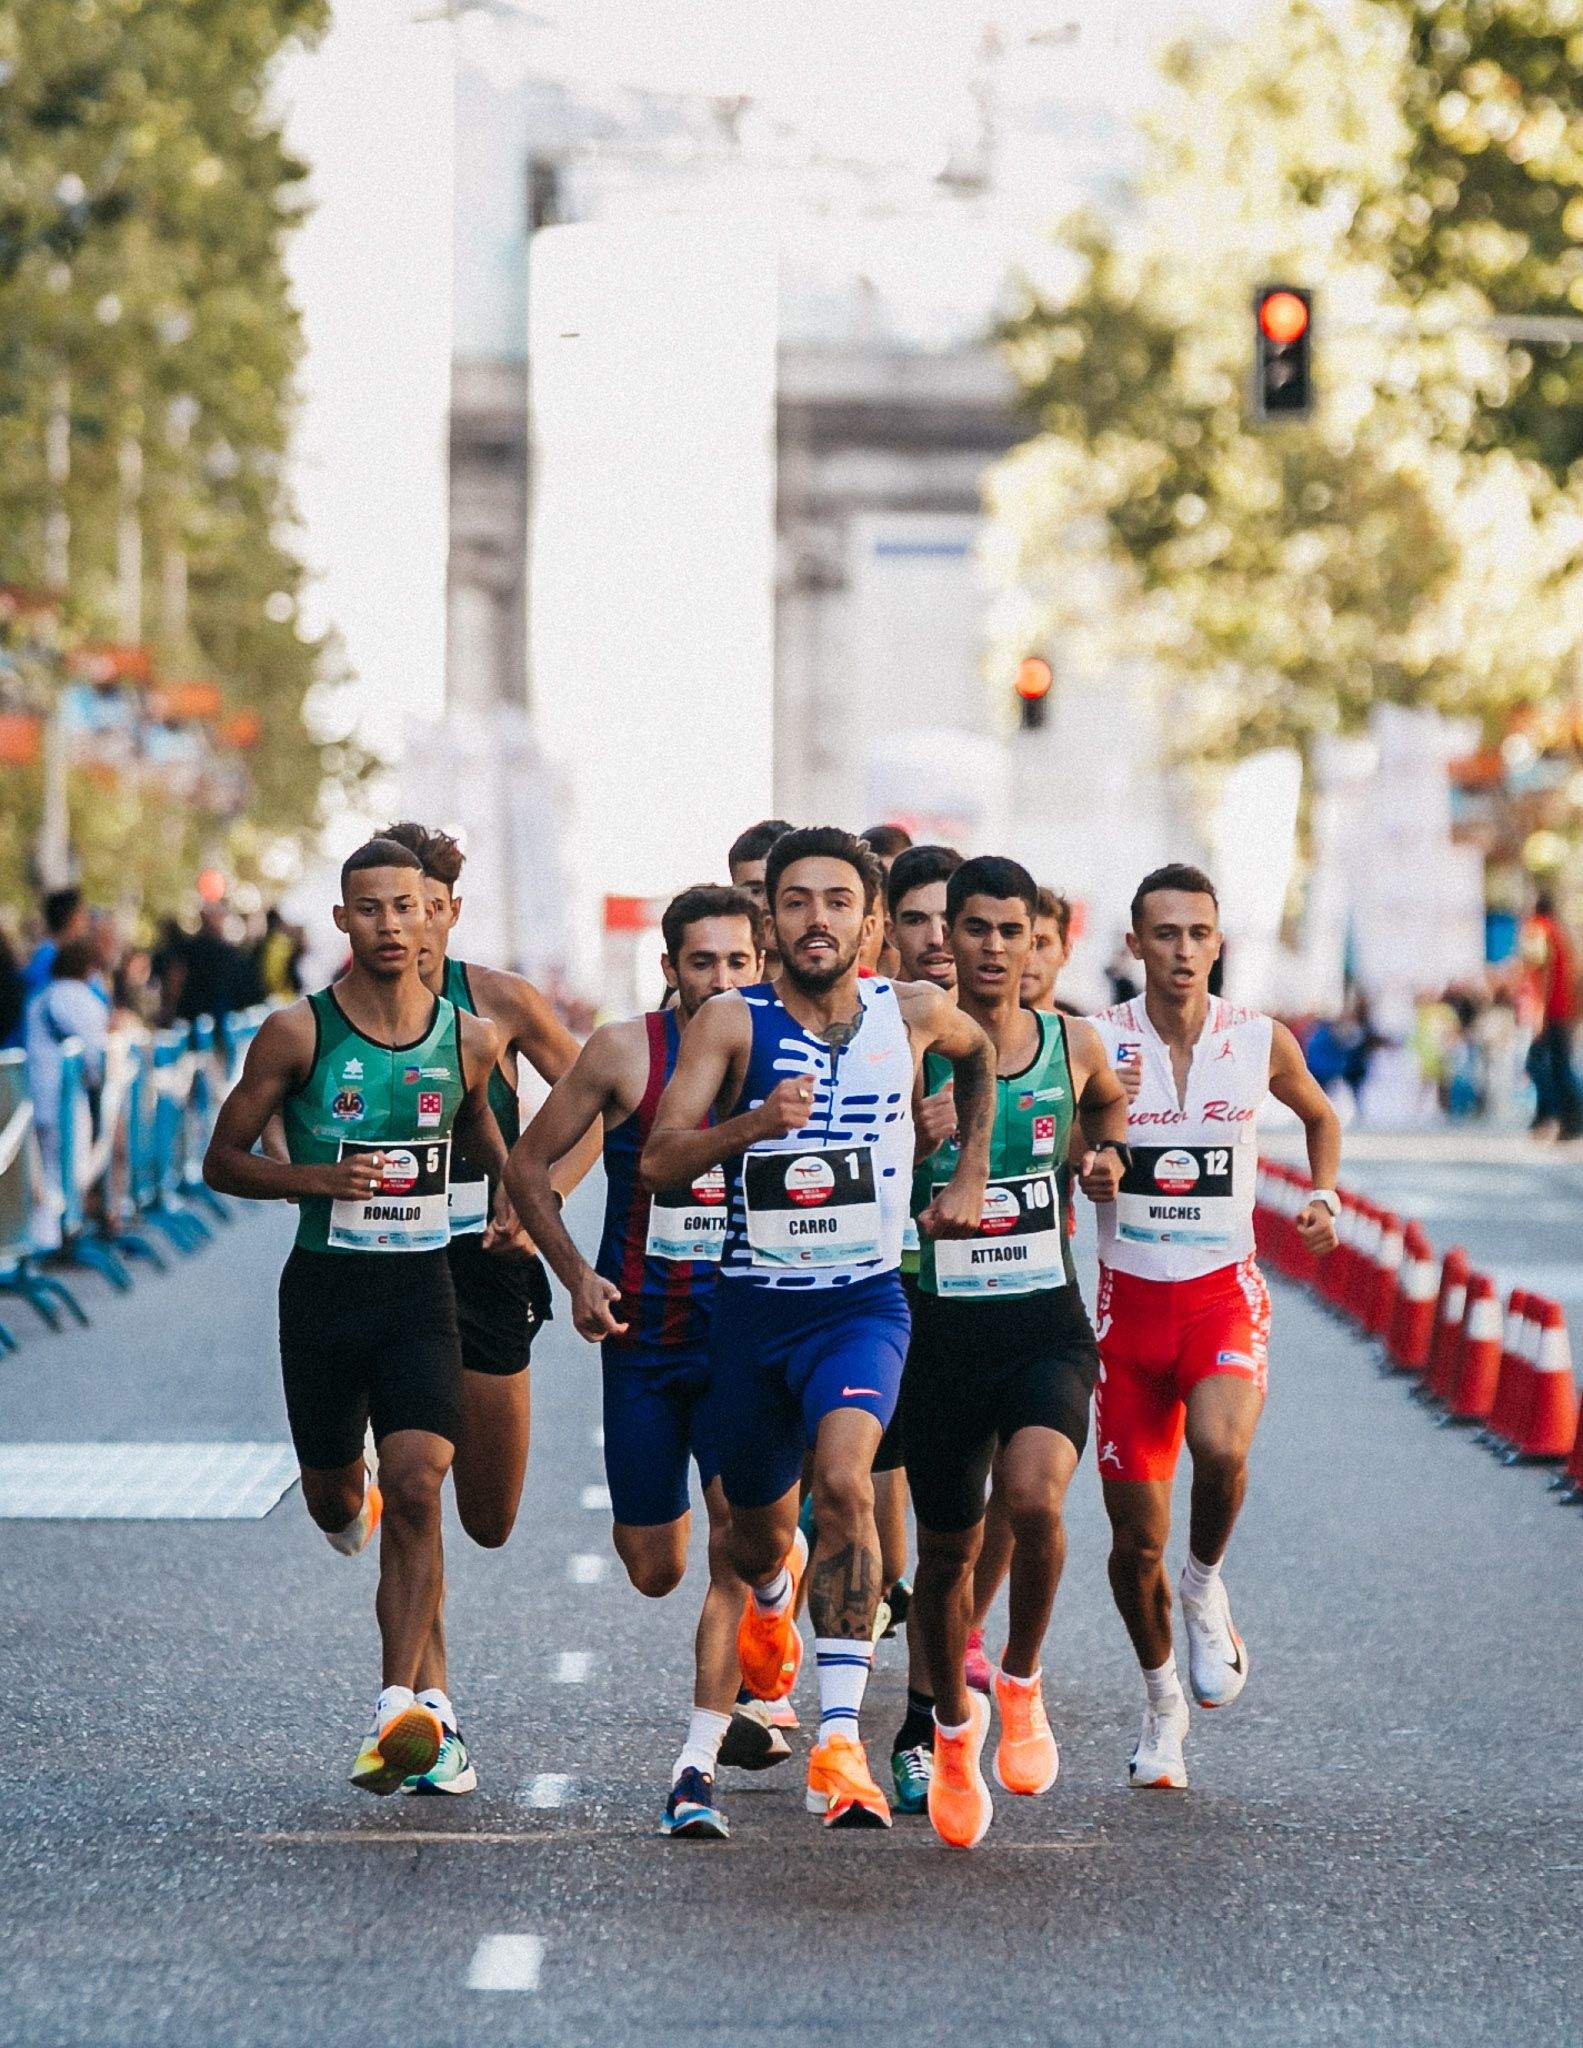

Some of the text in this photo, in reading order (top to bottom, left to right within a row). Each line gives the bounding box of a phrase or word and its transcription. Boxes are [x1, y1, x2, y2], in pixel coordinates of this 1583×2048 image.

[1127, 1099, 1255, 1126] uerto Rico
[426, 1147, 439, 1173] 5
[844, 1151, 860, 1180] 1
[1203, 1149, 1229, 1176] 12
[1021, 1180, 1051, 1210] 10
[363, 1205, 421, 1222] RONALDO
[1148, 1205, 1202, 1221] VILCHES
[788, 1217, 838, 1236] CARRO
[970, 1245, 1028, 1264] ATTAOUI
